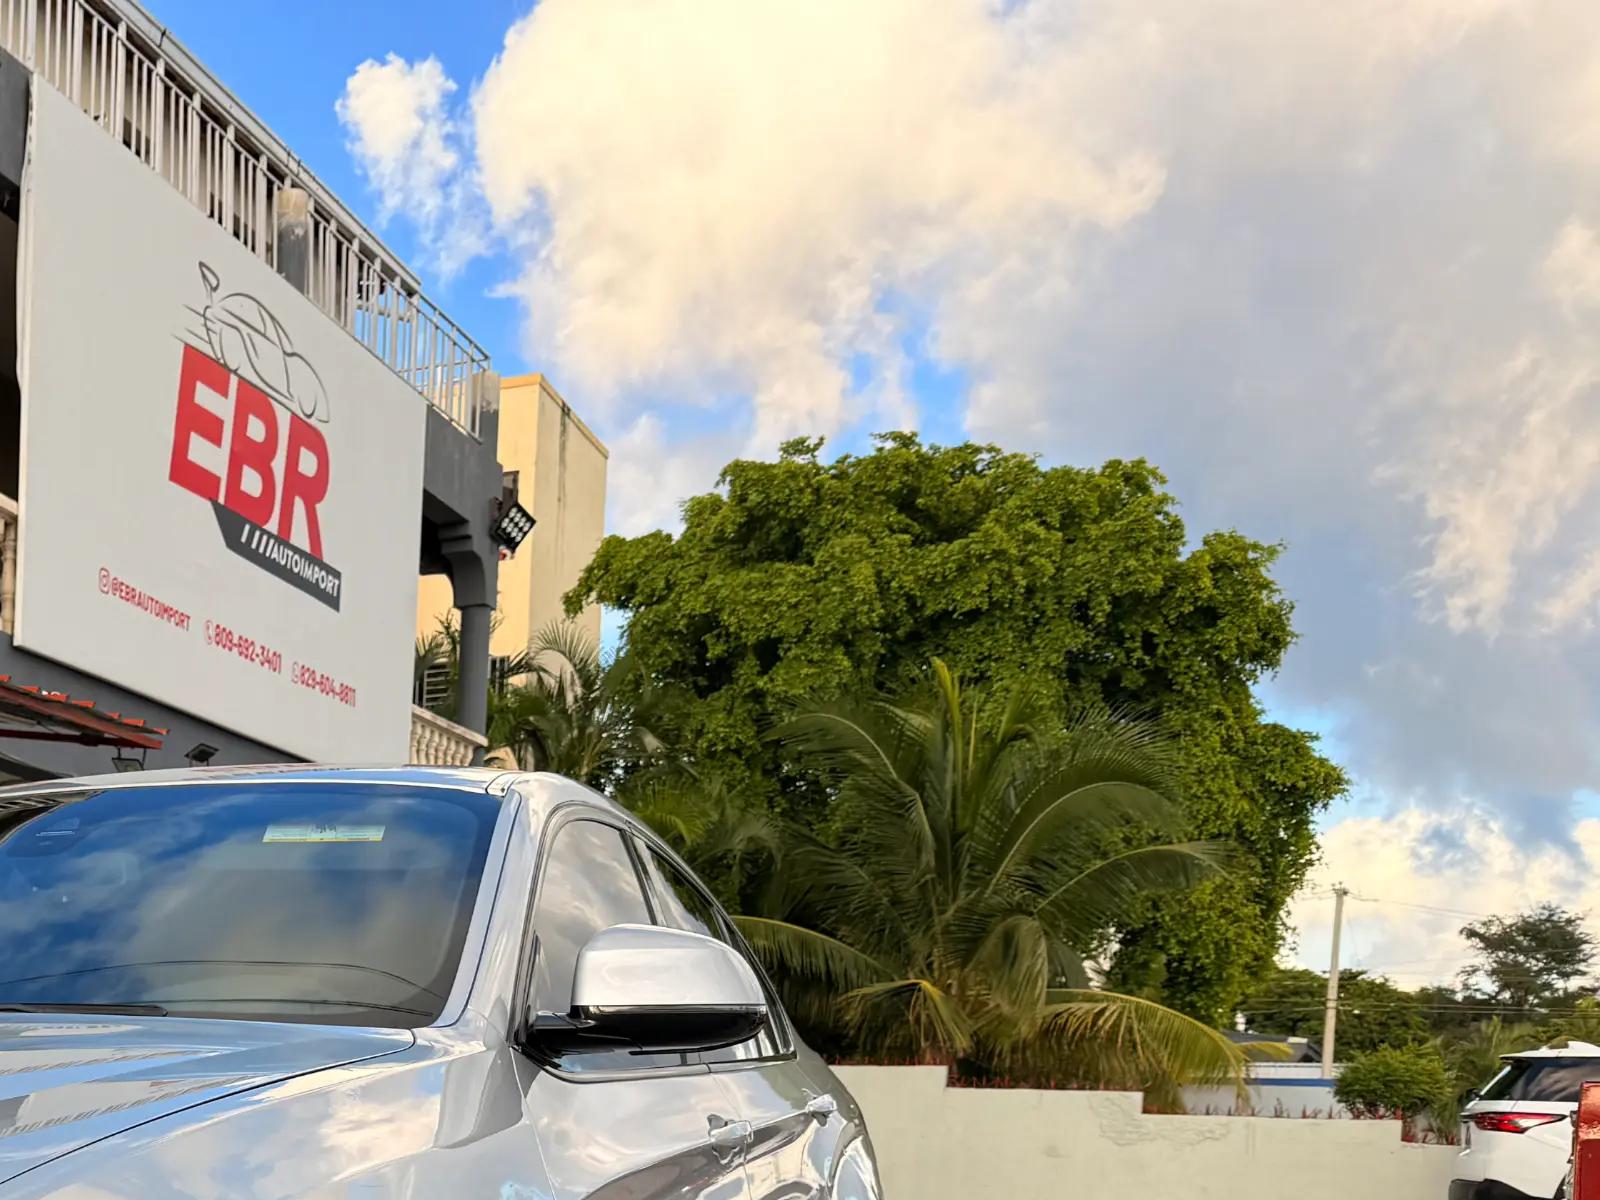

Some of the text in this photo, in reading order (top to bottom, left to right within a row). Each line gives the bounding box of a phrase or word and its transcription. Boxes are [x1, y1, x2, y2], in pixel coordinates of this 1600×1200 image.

[169, 344, 330, 560] EBR
[271, 541, 339, 597] AUTOIMPORT
[111, 577, 191, 631] @EBRAUTOIMPORT
[213, 624, 282, 674] 809-692-3401
